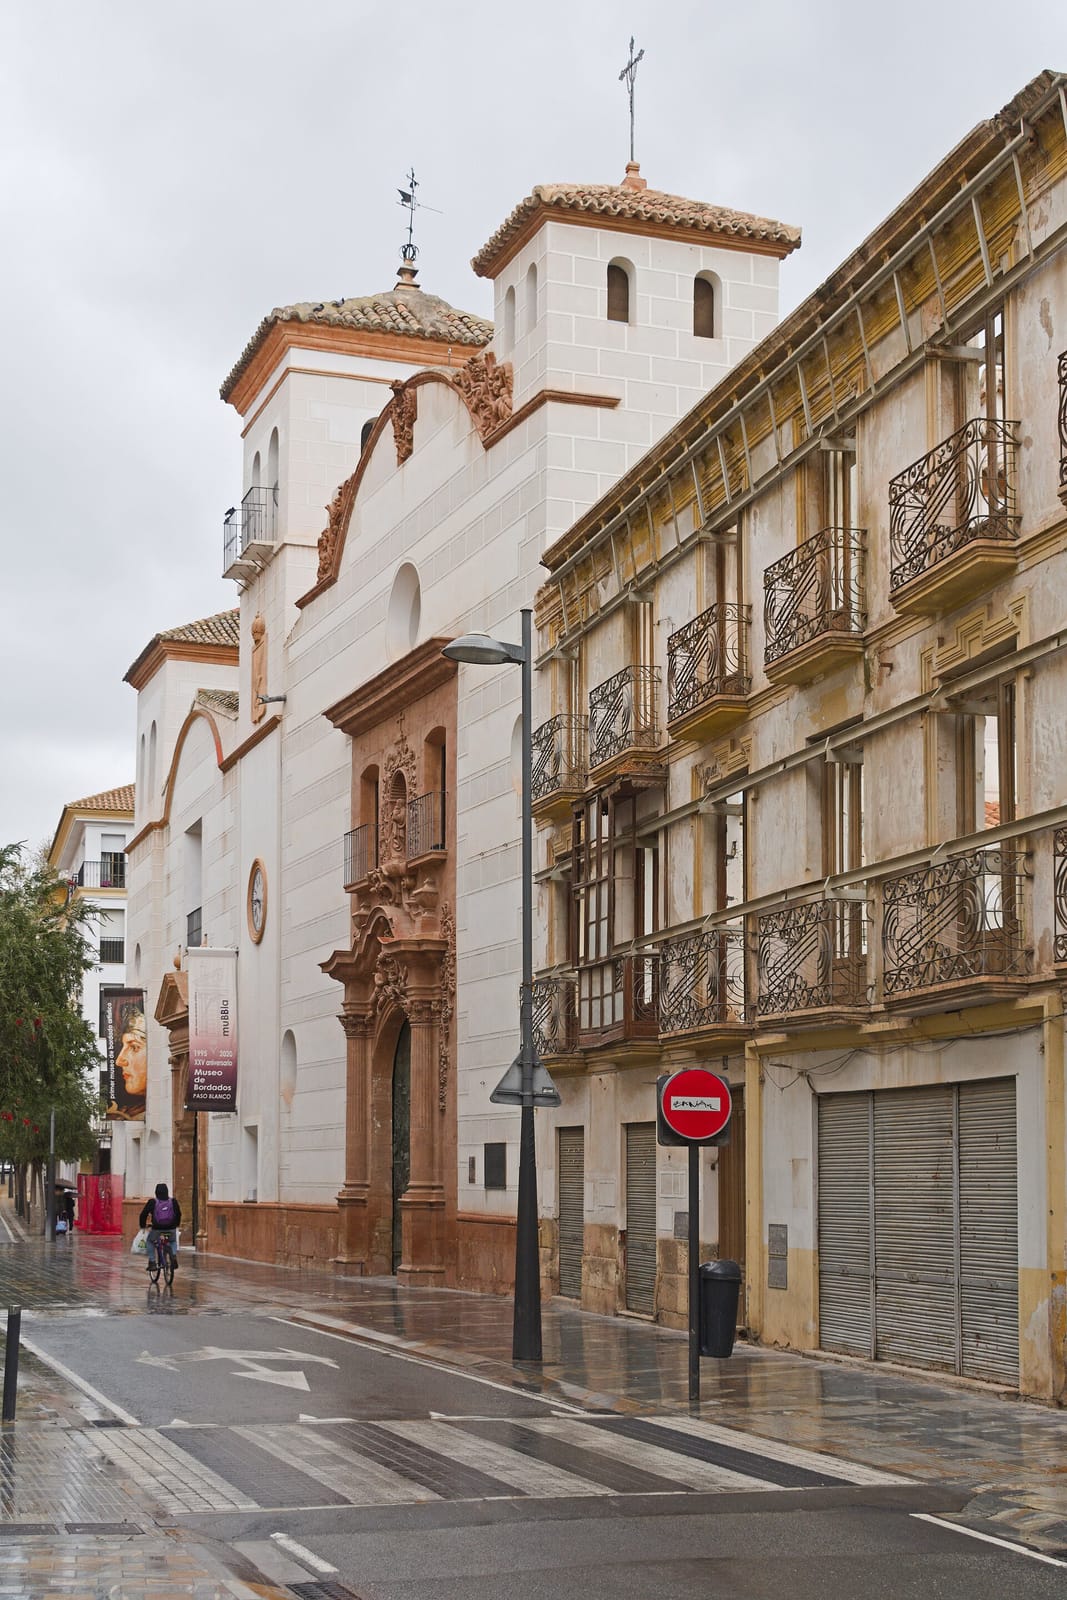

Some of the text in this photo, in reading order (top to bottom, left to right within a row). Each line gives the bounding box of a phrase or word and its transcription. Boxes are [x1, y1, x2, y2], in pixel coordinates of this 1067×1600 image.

[220, 999, 229, 1036] muBBla
[109, 1050, 115, 1058] de
[194, 1068, 223, 1076] Museo
